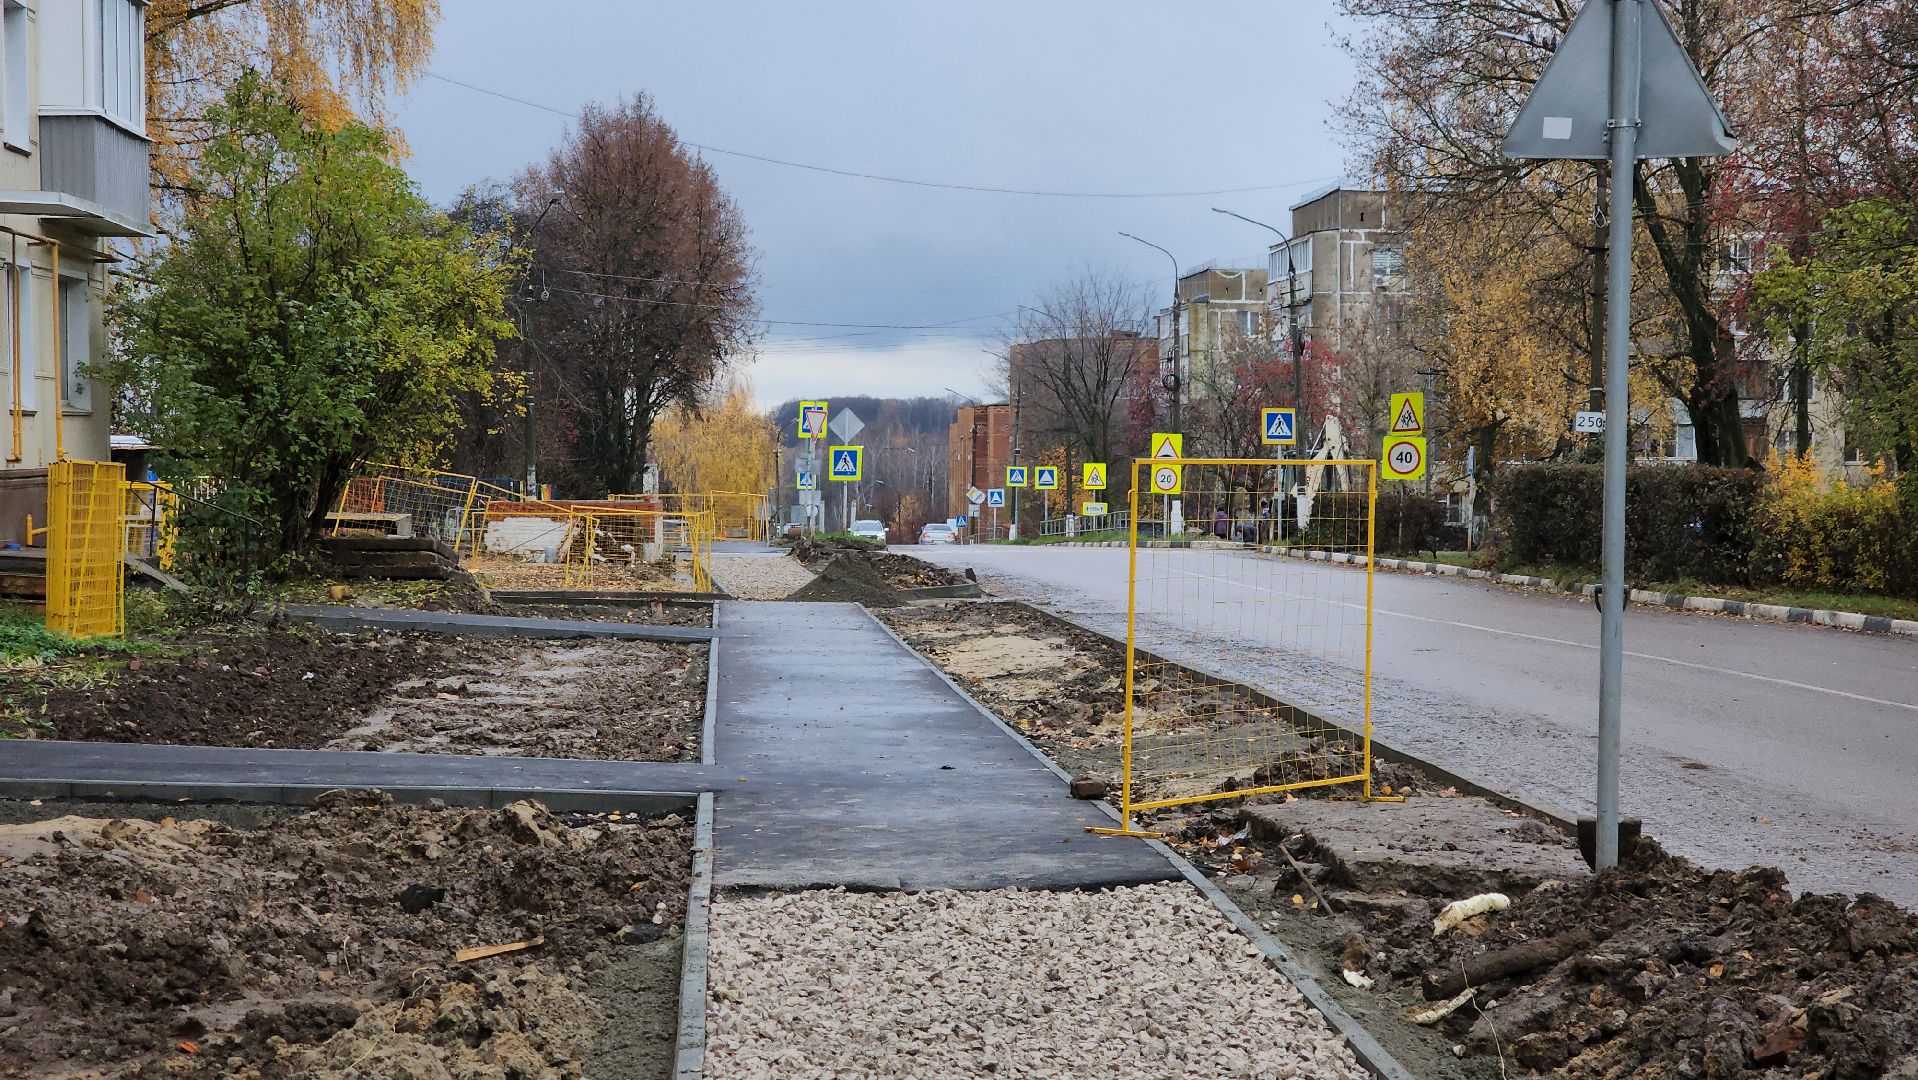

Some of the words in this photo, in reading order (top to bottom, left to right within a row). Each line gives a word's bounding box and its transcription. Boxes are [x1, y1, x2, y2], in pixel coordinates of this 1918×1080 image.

[1578, 416, 1603, 428] 250
[1396, 451, 1413, 464] 40
[1160, 474, 1172, 484] 20
